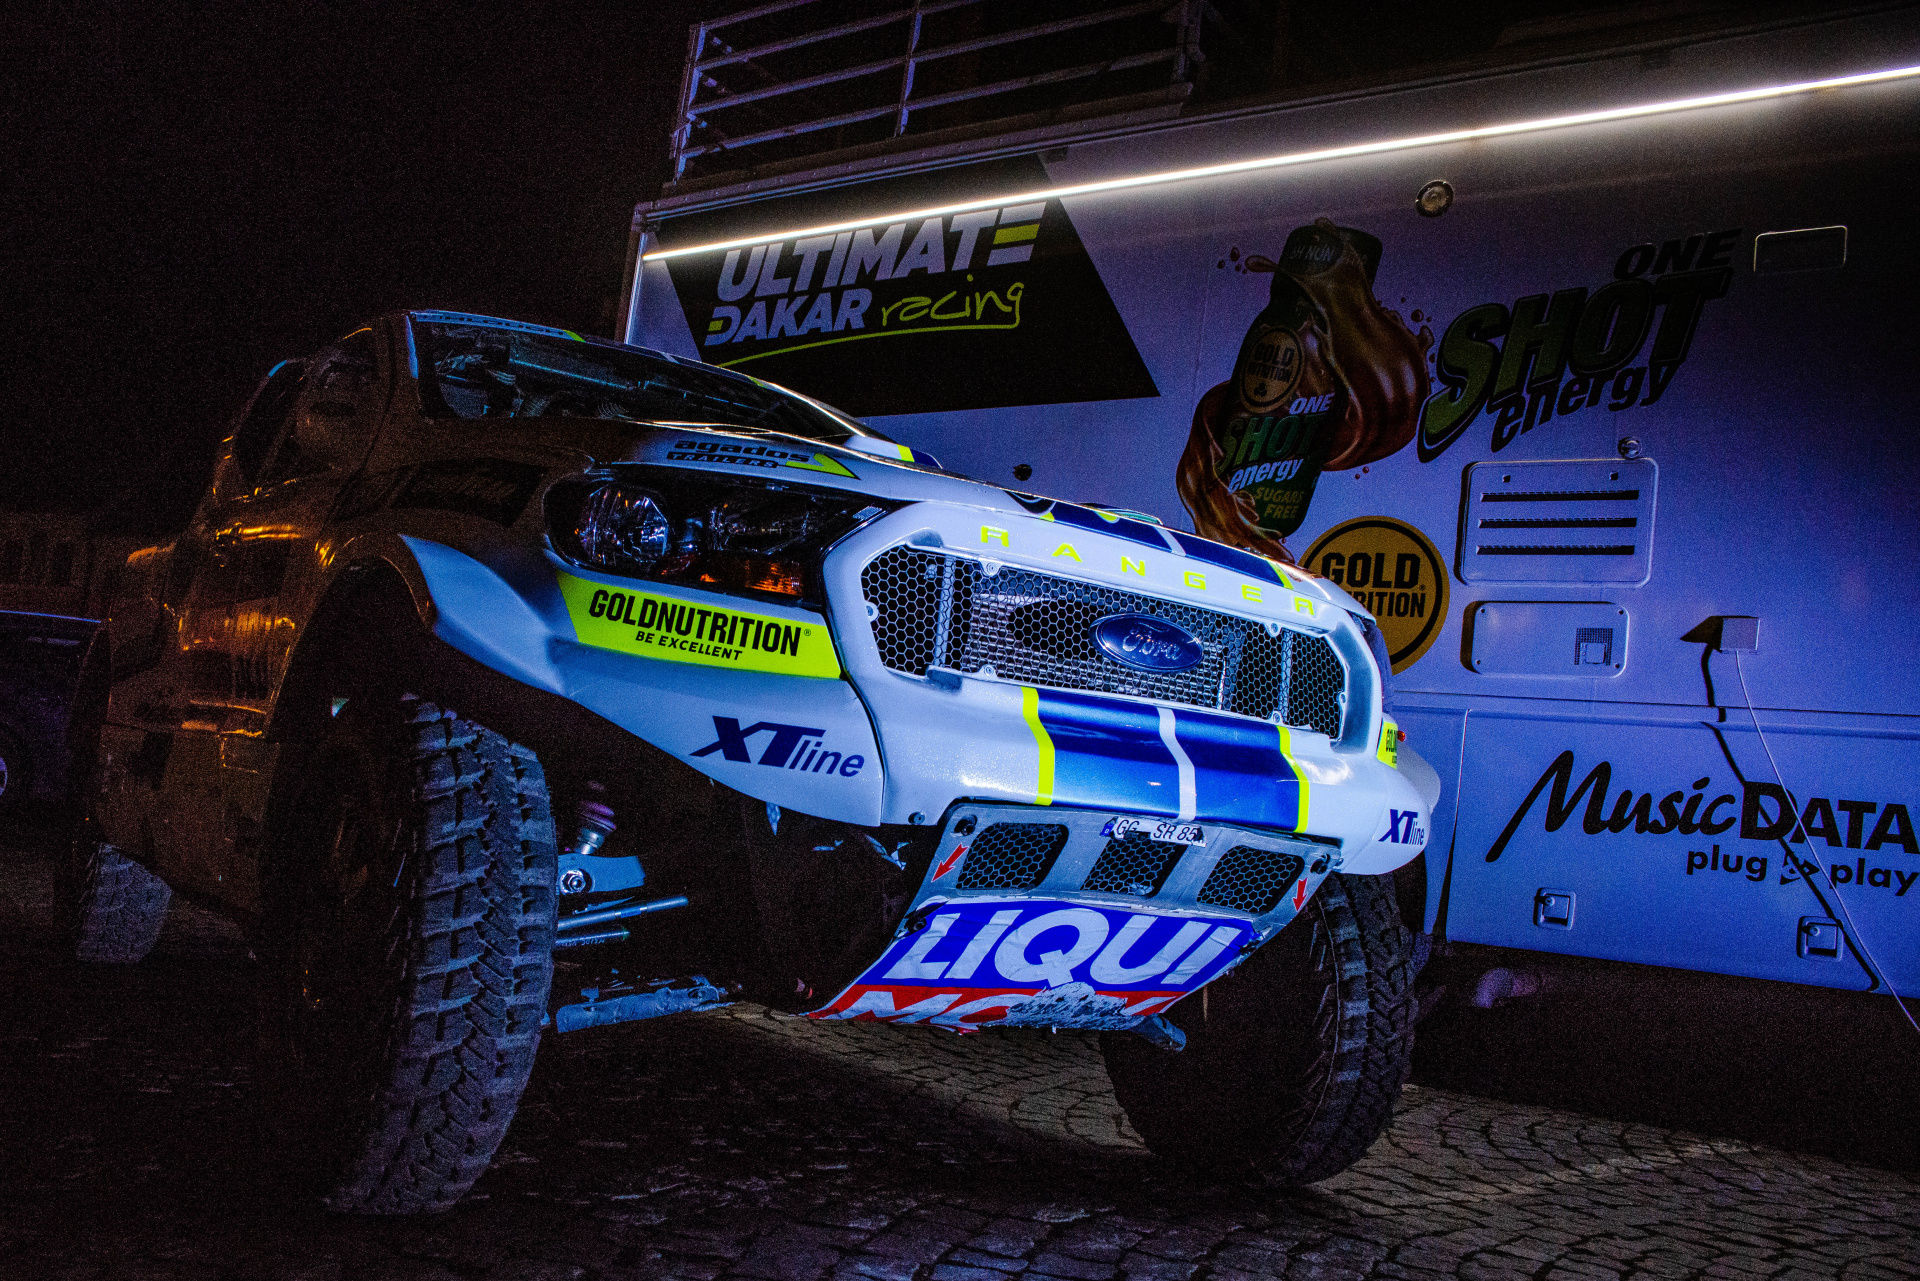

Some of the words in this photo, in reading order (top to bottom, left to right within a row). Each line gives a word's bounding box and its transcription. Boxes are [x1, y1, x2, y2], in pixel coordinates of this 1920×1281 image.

[716, 201, 1047, 303] ULTIMATE
[1613, 228, 1742, 279] ONE
[705, 288, 873, 346] DAKAR
[881, 274, 1024, 328] racing
[1417, 266, 1736, 462] SHOT
[1289, 393, 1336, 414] ONE
[1487, 361, 1681, 452] energy
[675, 440, 811, 462] agados
[1228, 459, 1304, 494] energy
[1263, 503, 1301, 520] FREE
[980, 525, 1316, 616] RANGER
[1321, 553, 1420, 588] GOLD
[588, 590, 801, 656] GOLDNUTRITION
[635, 631, 654, 644] BE
[658, 636, 742, 660] EXCELLENT
[1122, 630, 1183, 660] Ford
[689, 715, 865, 777] XTline
[1686, 844, 1768, 882] plug
[1828, 858, 1919, 897] play
[882, 907, 1245, 986] LIQUI
